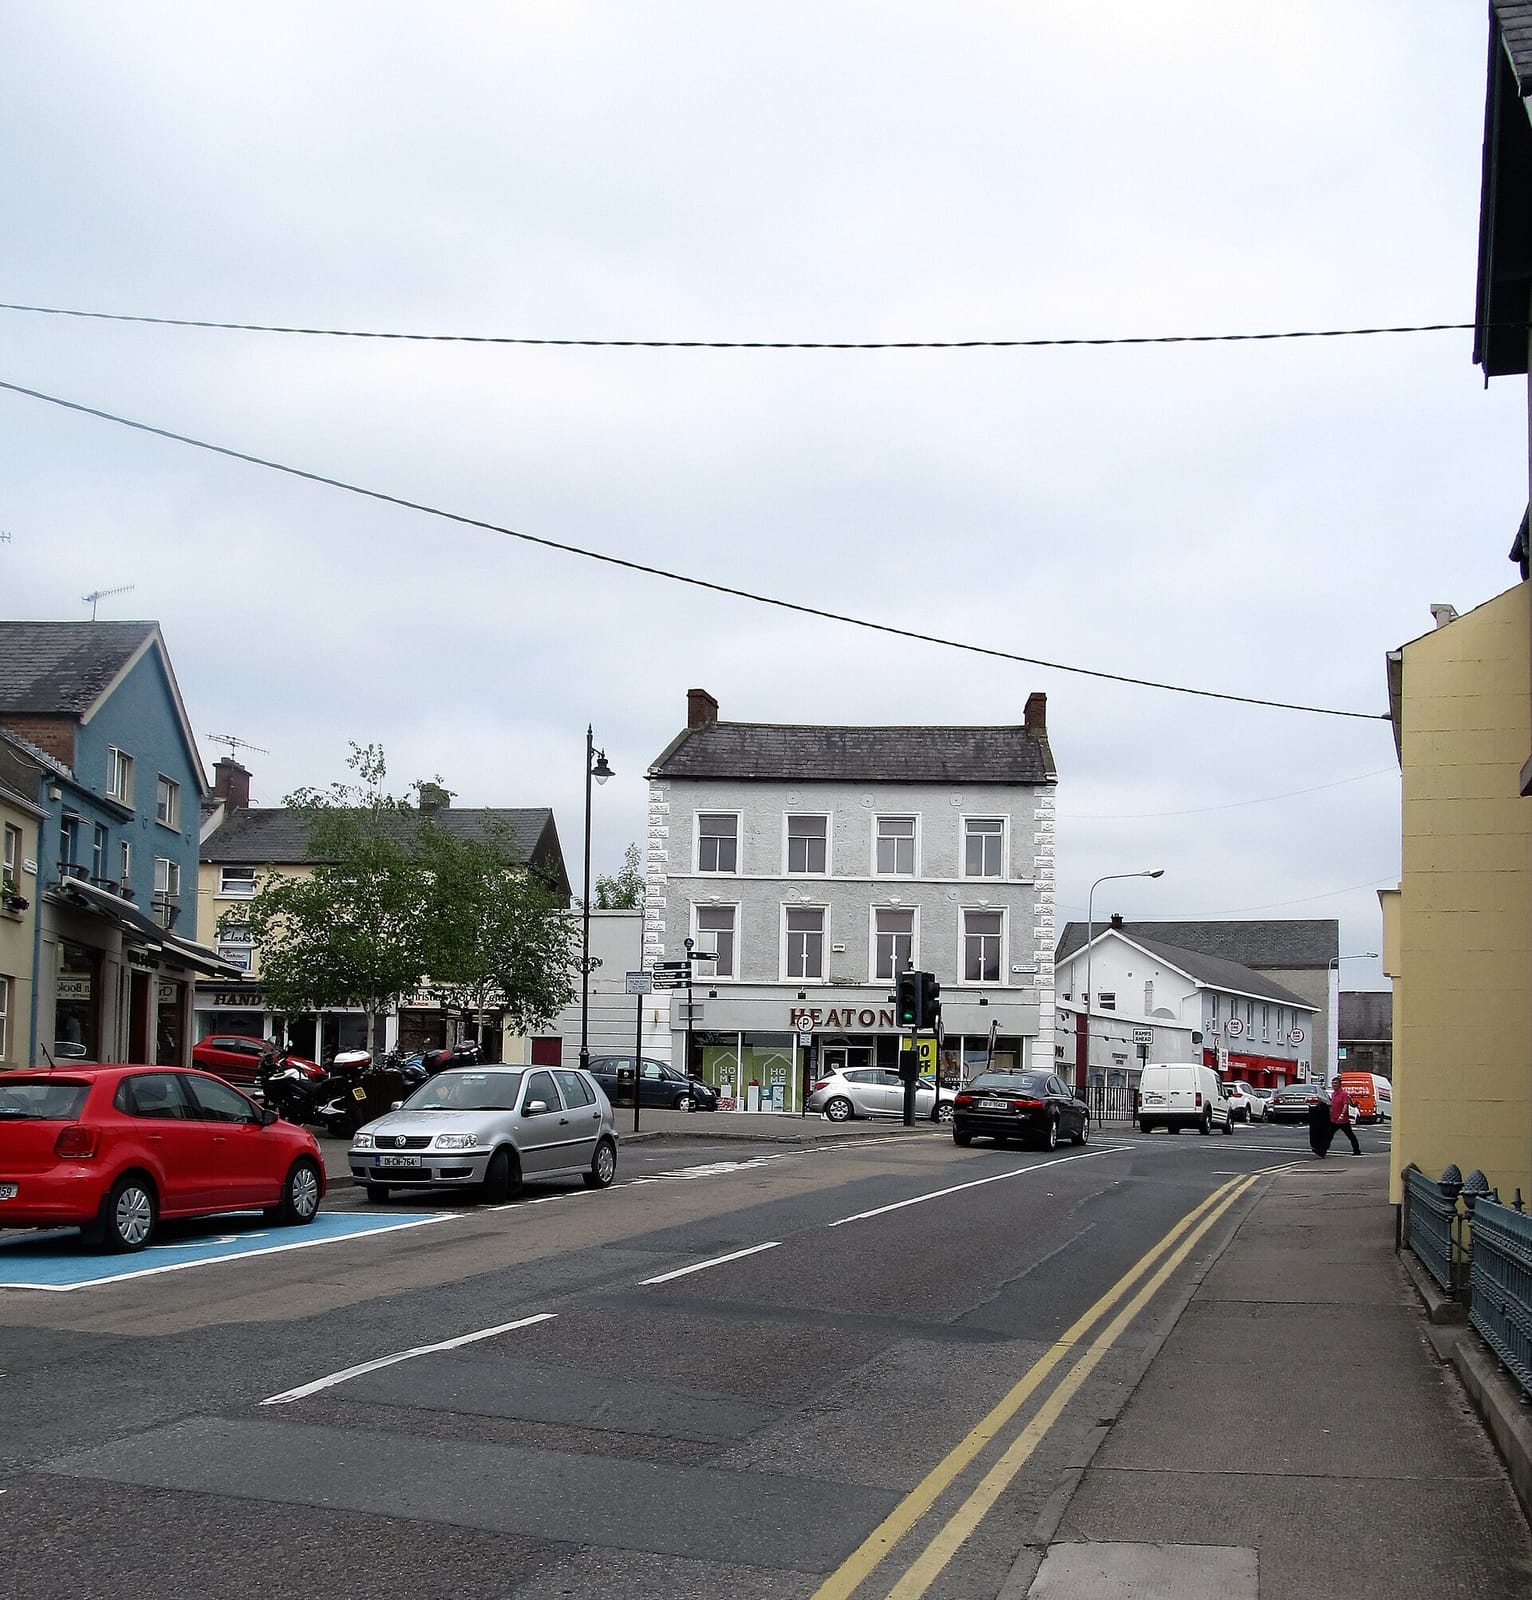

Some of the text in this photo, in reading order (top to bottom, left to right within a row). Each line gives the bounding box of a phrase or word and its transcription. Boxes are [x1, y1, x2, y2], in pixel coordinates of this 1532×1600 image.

[214, 993, 262, 1006] HAND
[790, 1008, 896, 1028] HEATON
[0, 1186, 12, 1197] 59
